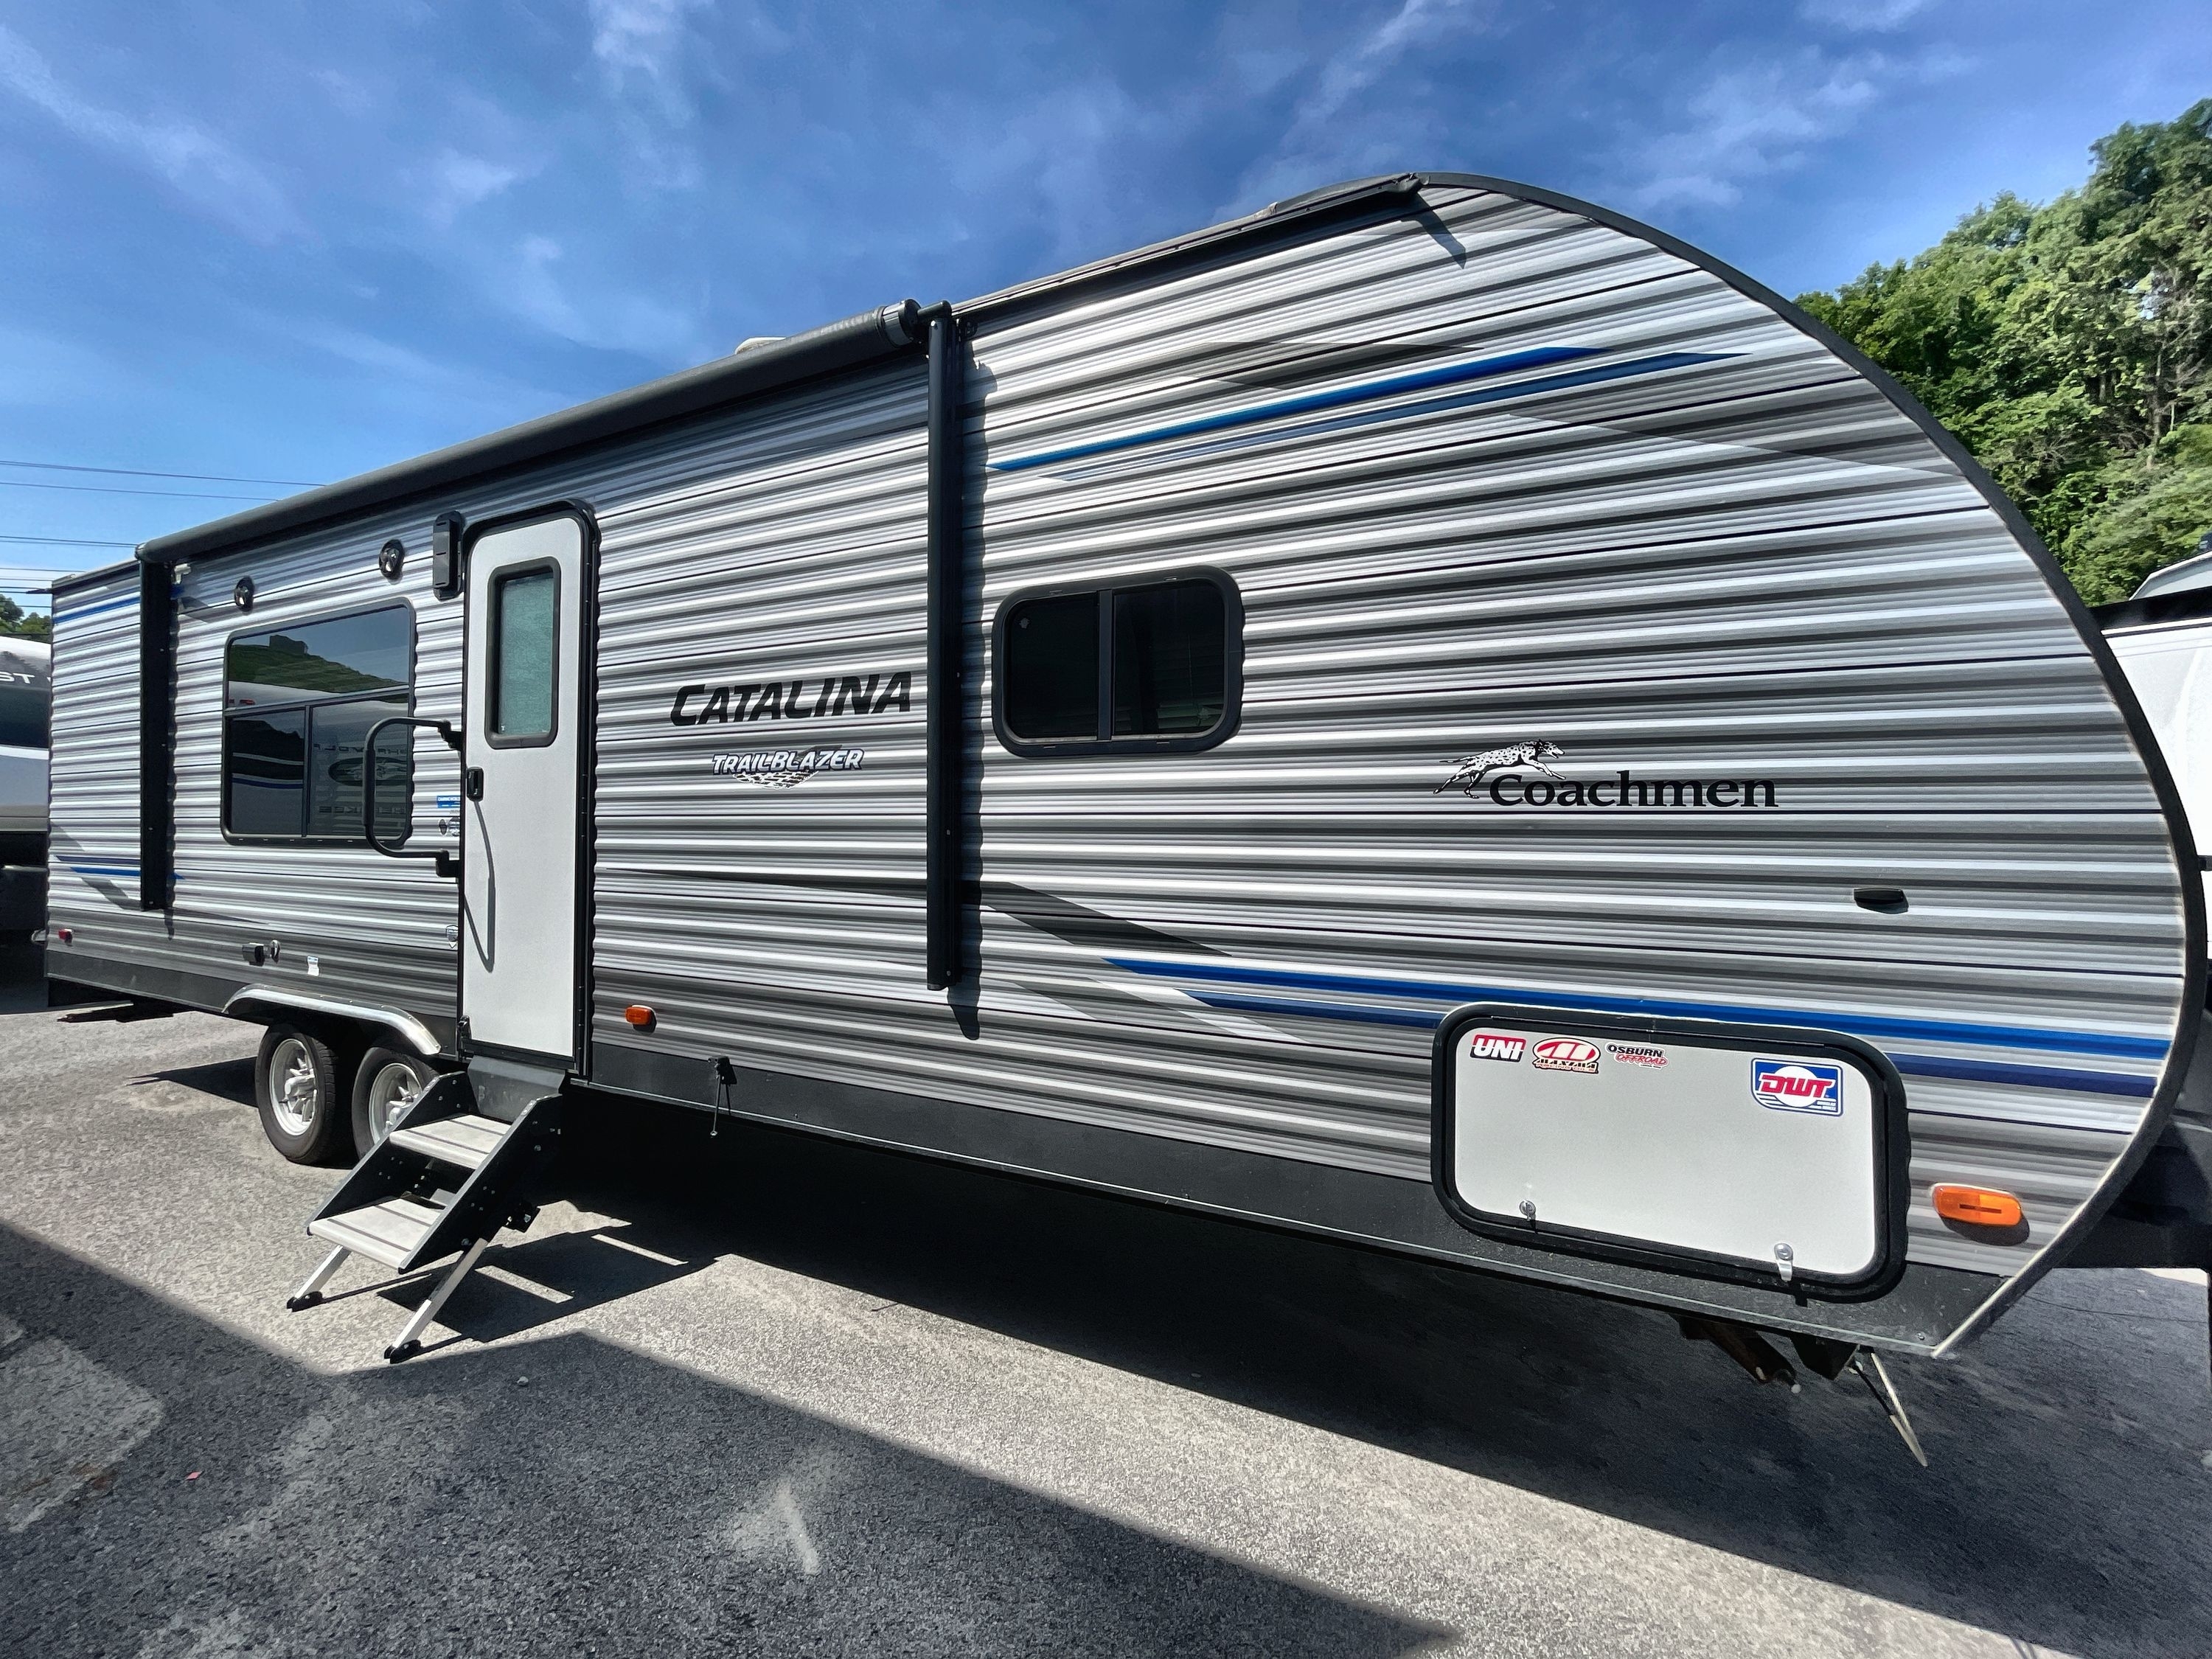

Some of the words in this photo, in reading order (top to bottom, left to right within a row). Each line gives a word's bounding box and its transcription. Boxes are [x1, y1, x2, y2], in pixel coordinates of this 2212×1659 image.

[669, 671, 912, 727] CATALINA
[712, 748, 865, 776] TRAILBLAZER
[1489, 770, 1779, 808] Coachmen
[1473, 1037, 1524, 1060] UNI
[1607, 1044, 1663, 1058] OSBURN
[1616, 1054, 1667, 1065] OFFROAD
[1760, 1074, 1833, 1099] DWT
